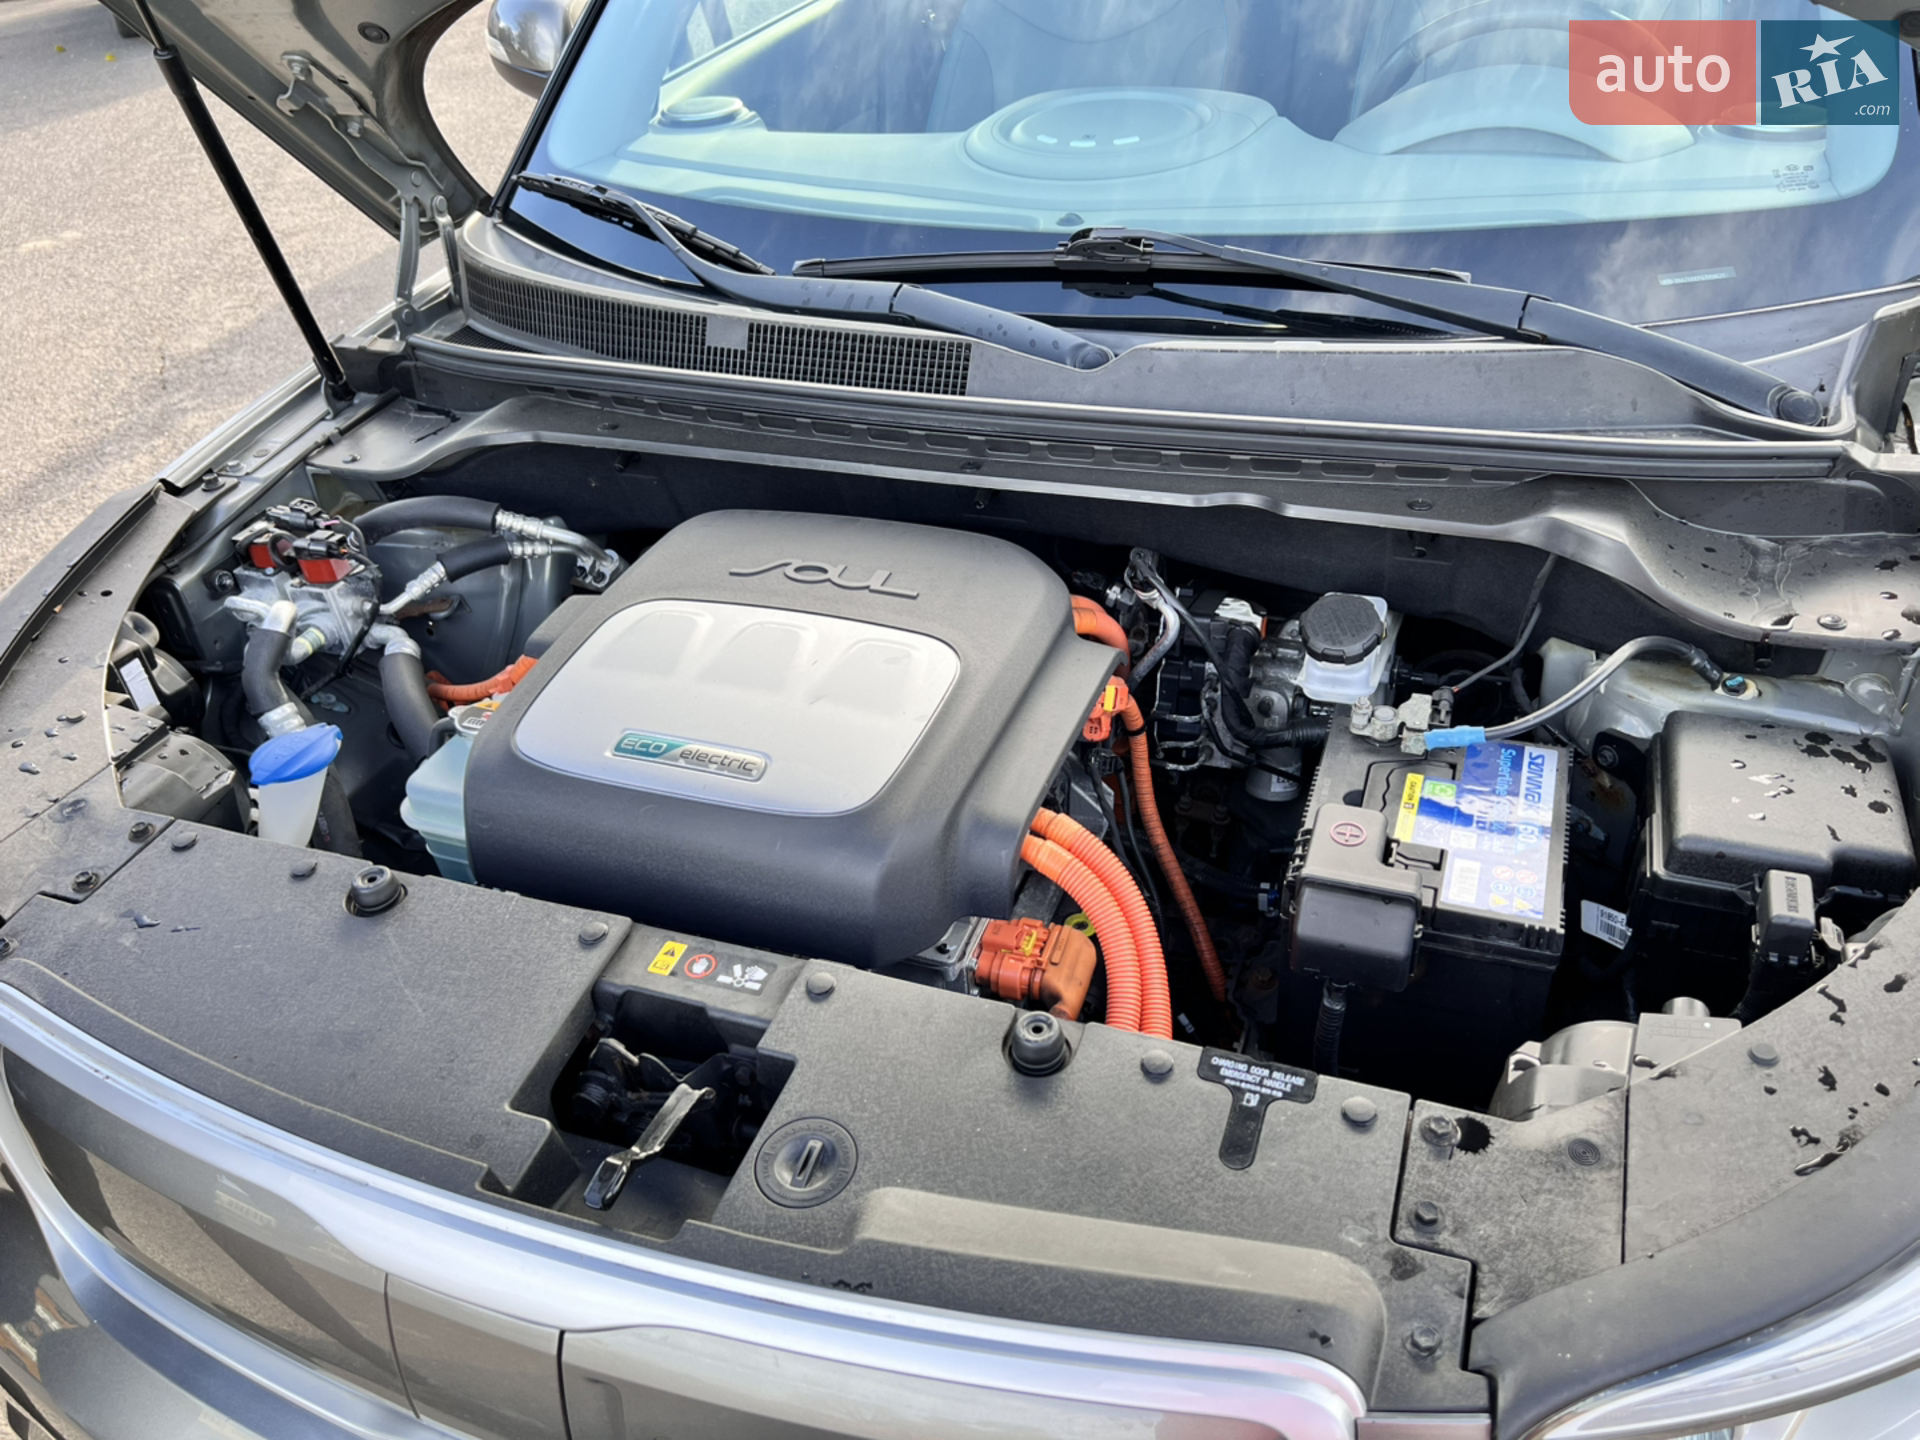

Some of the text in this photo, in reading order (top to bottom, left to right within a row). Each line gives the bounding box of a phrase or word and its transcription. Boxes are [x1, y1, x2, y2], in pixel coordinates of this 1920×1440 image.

[621, 736, 758, 773] ECO electric
[1219, 1067, 1261, 1084] EMERGENCY
[1262, 1077, 1293, 1092] HANDLE
[1271, 1070, 1306, 1087] RELEASE
